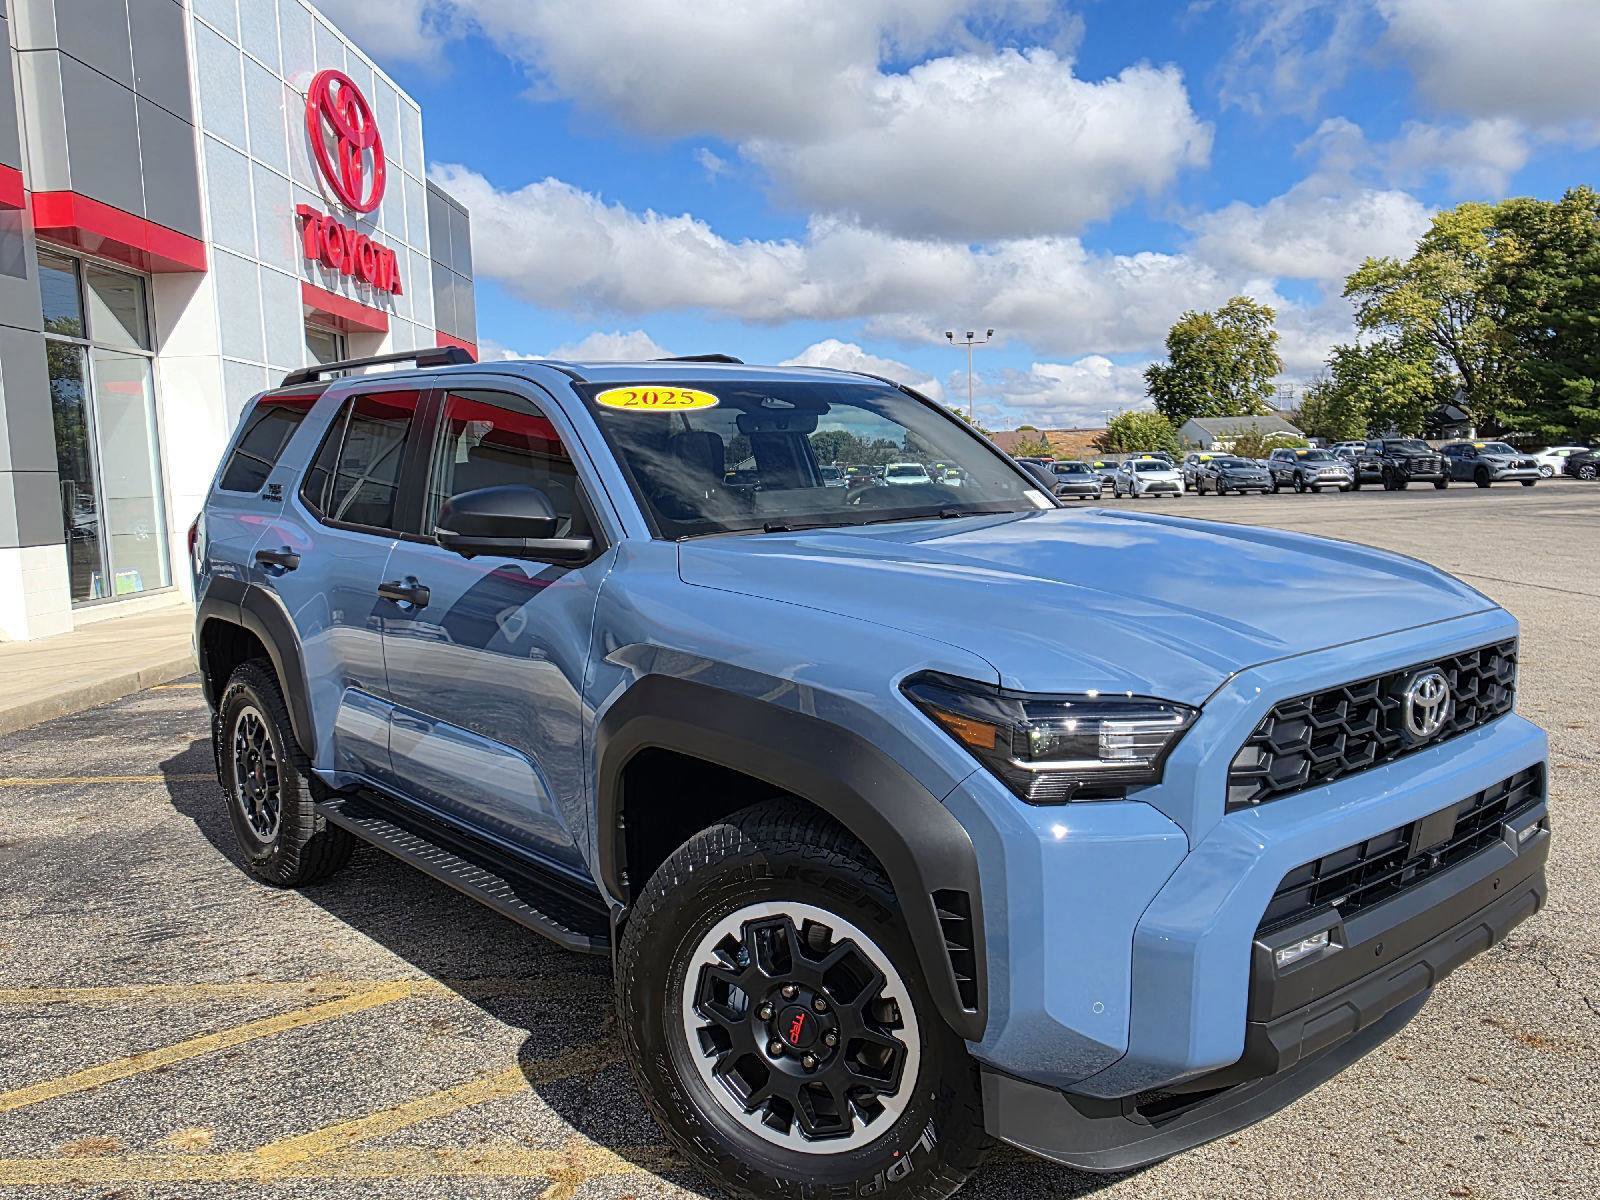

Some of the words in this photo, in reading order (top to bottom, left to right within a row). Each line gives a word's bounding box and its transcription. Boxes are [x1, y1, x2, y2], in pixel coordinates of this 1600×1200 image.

[296, 204, 403, 296] TOYOTA
[624, 392, 694, 406] 2025
[790, 1012, 806, 1046] TRD
